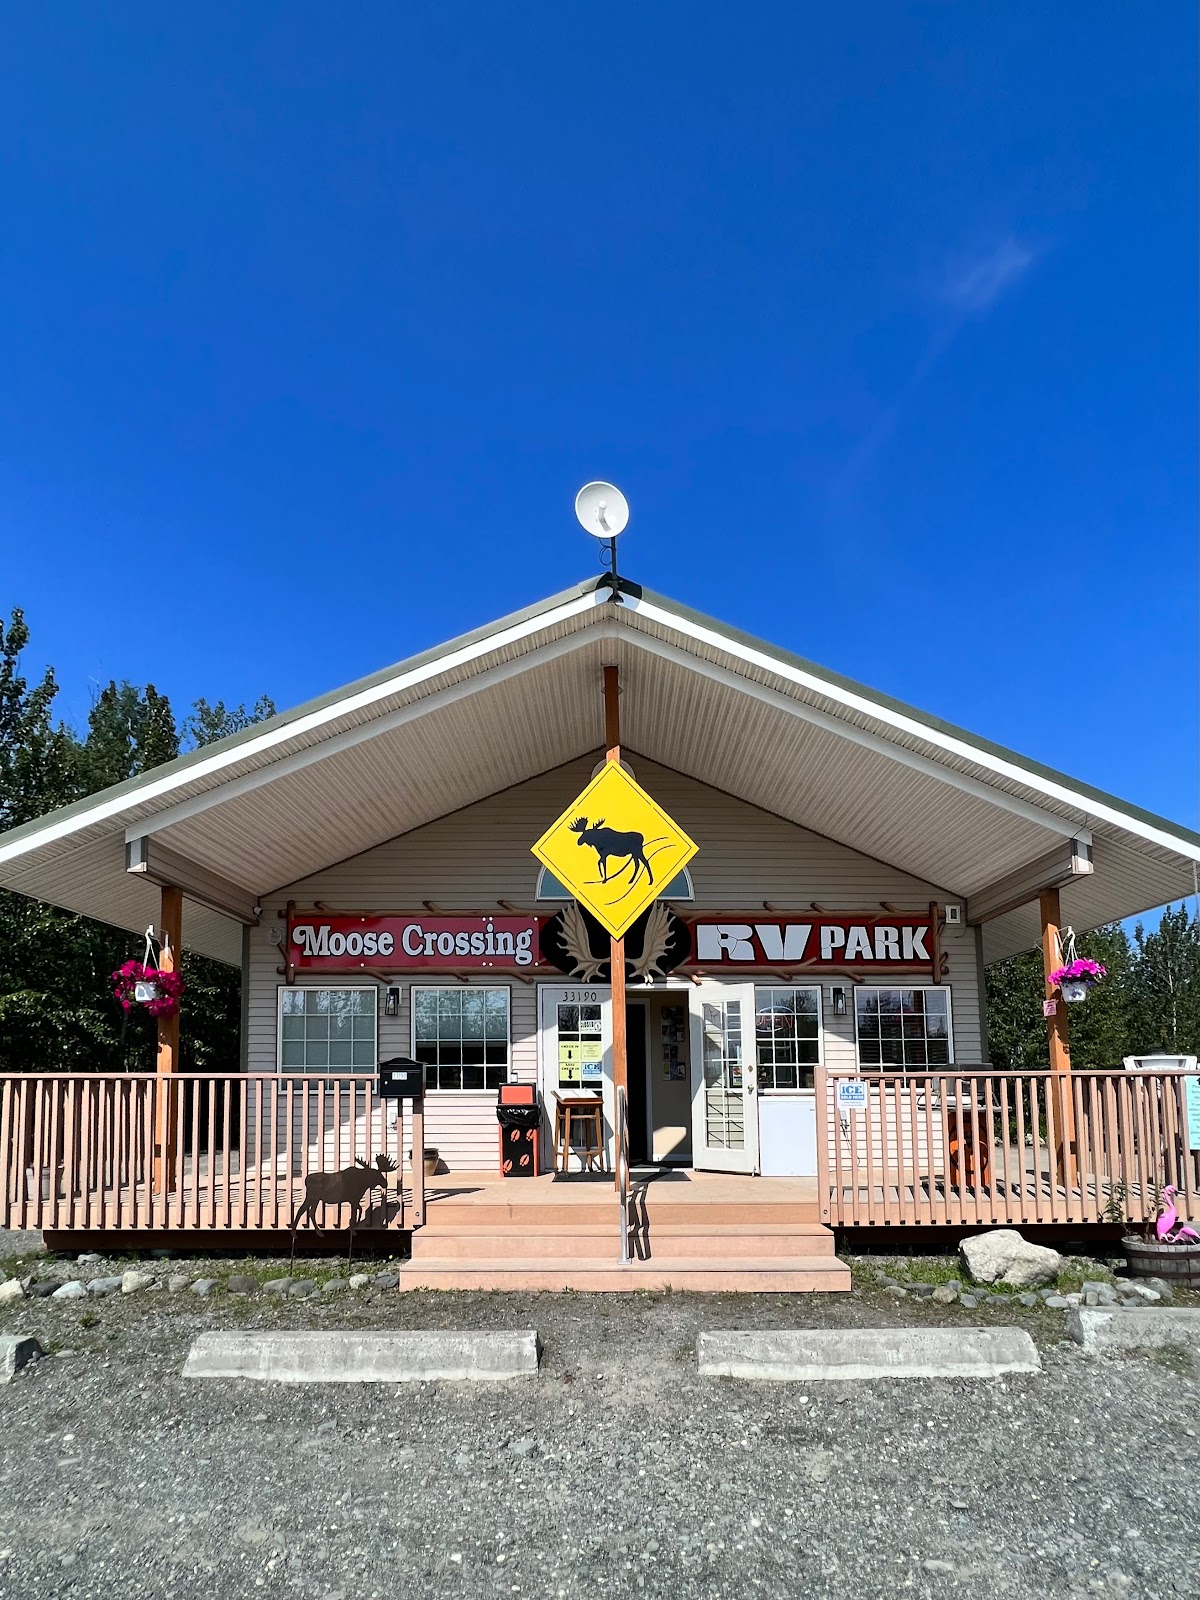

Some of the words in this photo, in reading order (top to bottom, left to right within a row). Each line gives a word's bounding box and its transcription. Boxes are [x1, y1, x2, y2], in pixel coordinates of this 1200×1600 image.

[292, 925, 394, 956] Moose
[402, 923, 533, 965] Crossing
[696, 924, 812, 960] RV
[820, 926, 931, 960] PARK
[562, 991, 597, 1002] 33190
[842, 1086, 862, 1094] ICE
